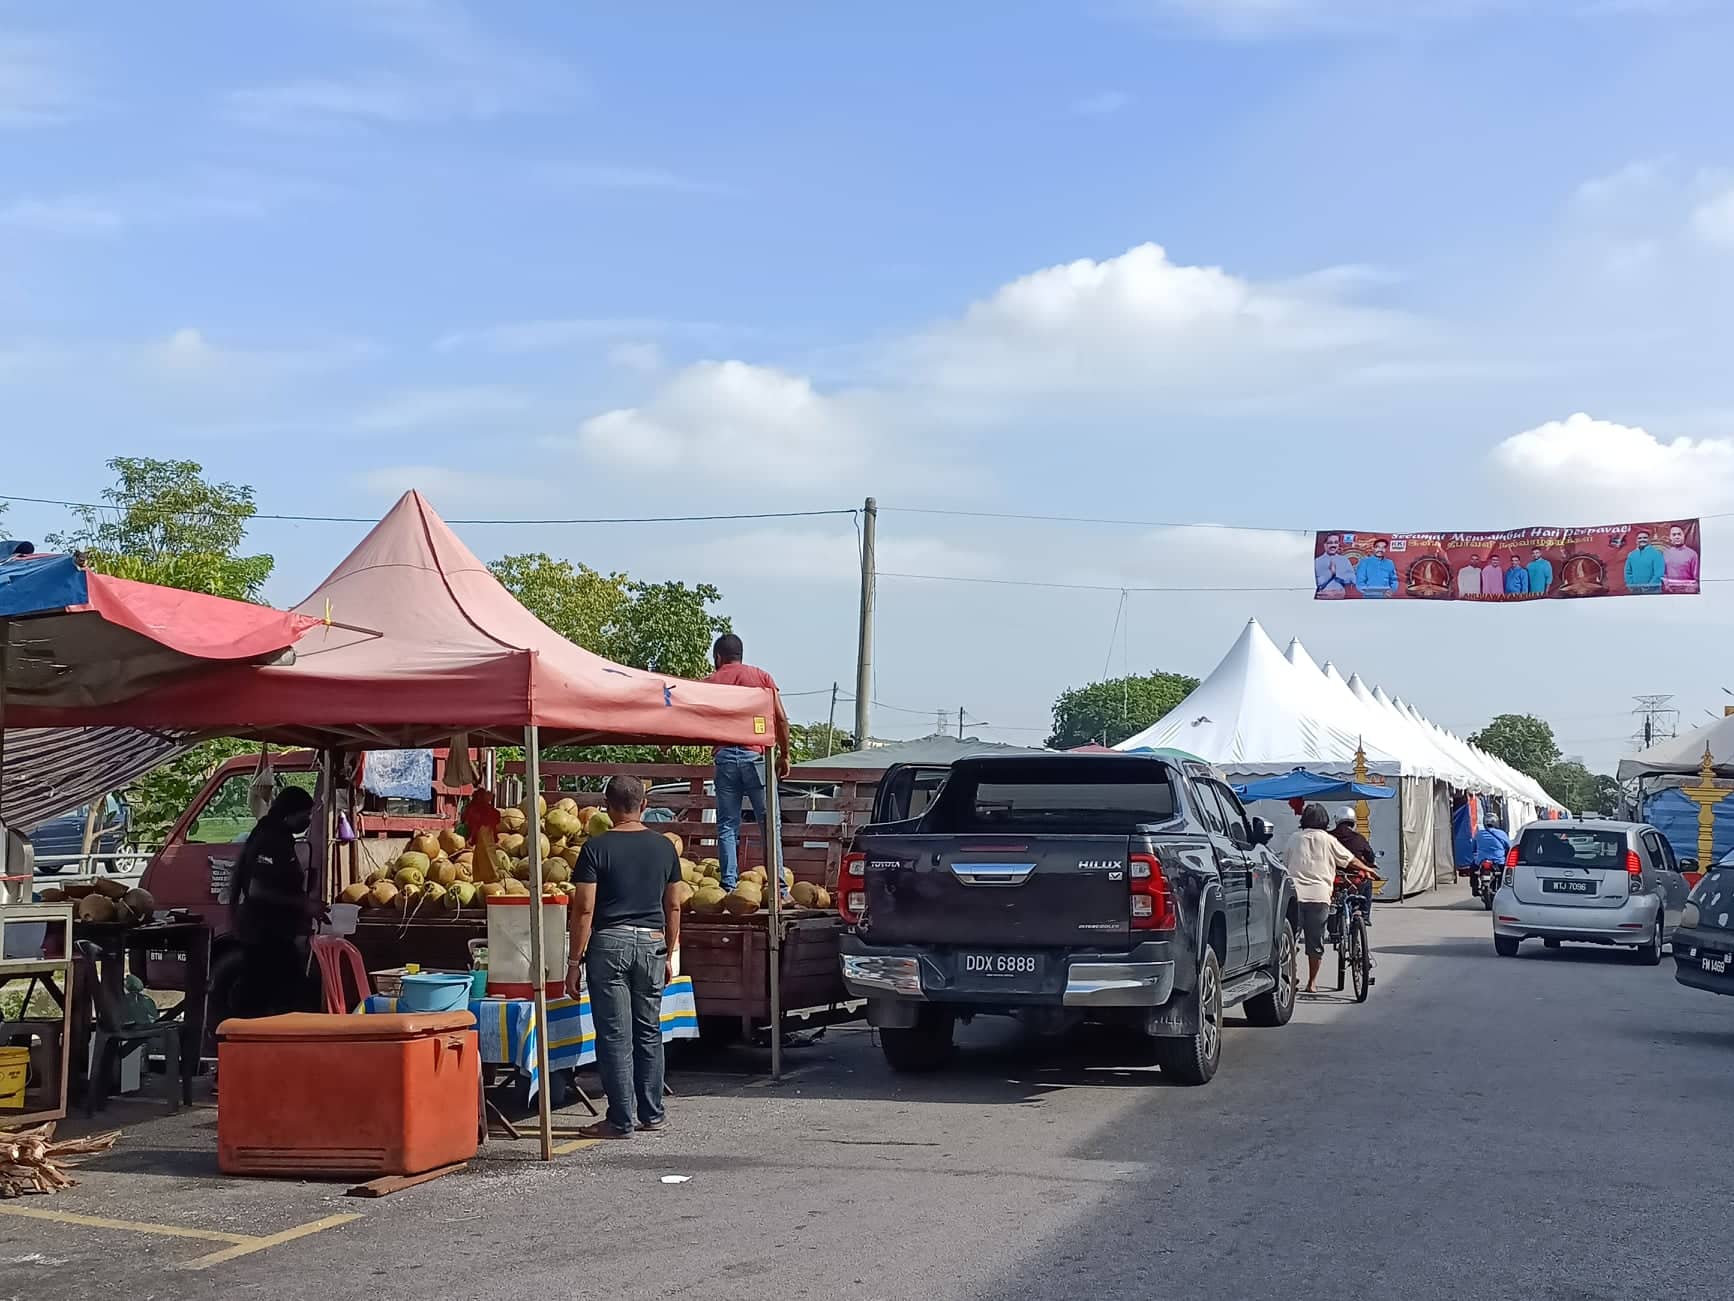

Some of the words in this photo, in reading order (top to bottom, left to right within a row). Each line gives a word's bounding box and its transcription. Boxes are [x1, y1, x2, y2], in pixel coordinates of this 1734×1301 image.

[1531, 527, 1560, 538] Hari
[1078, 860, 1122, 869] HILUX
[966, 955, 993, 971] DDX
[997, 956, 1035, 972] 6888
